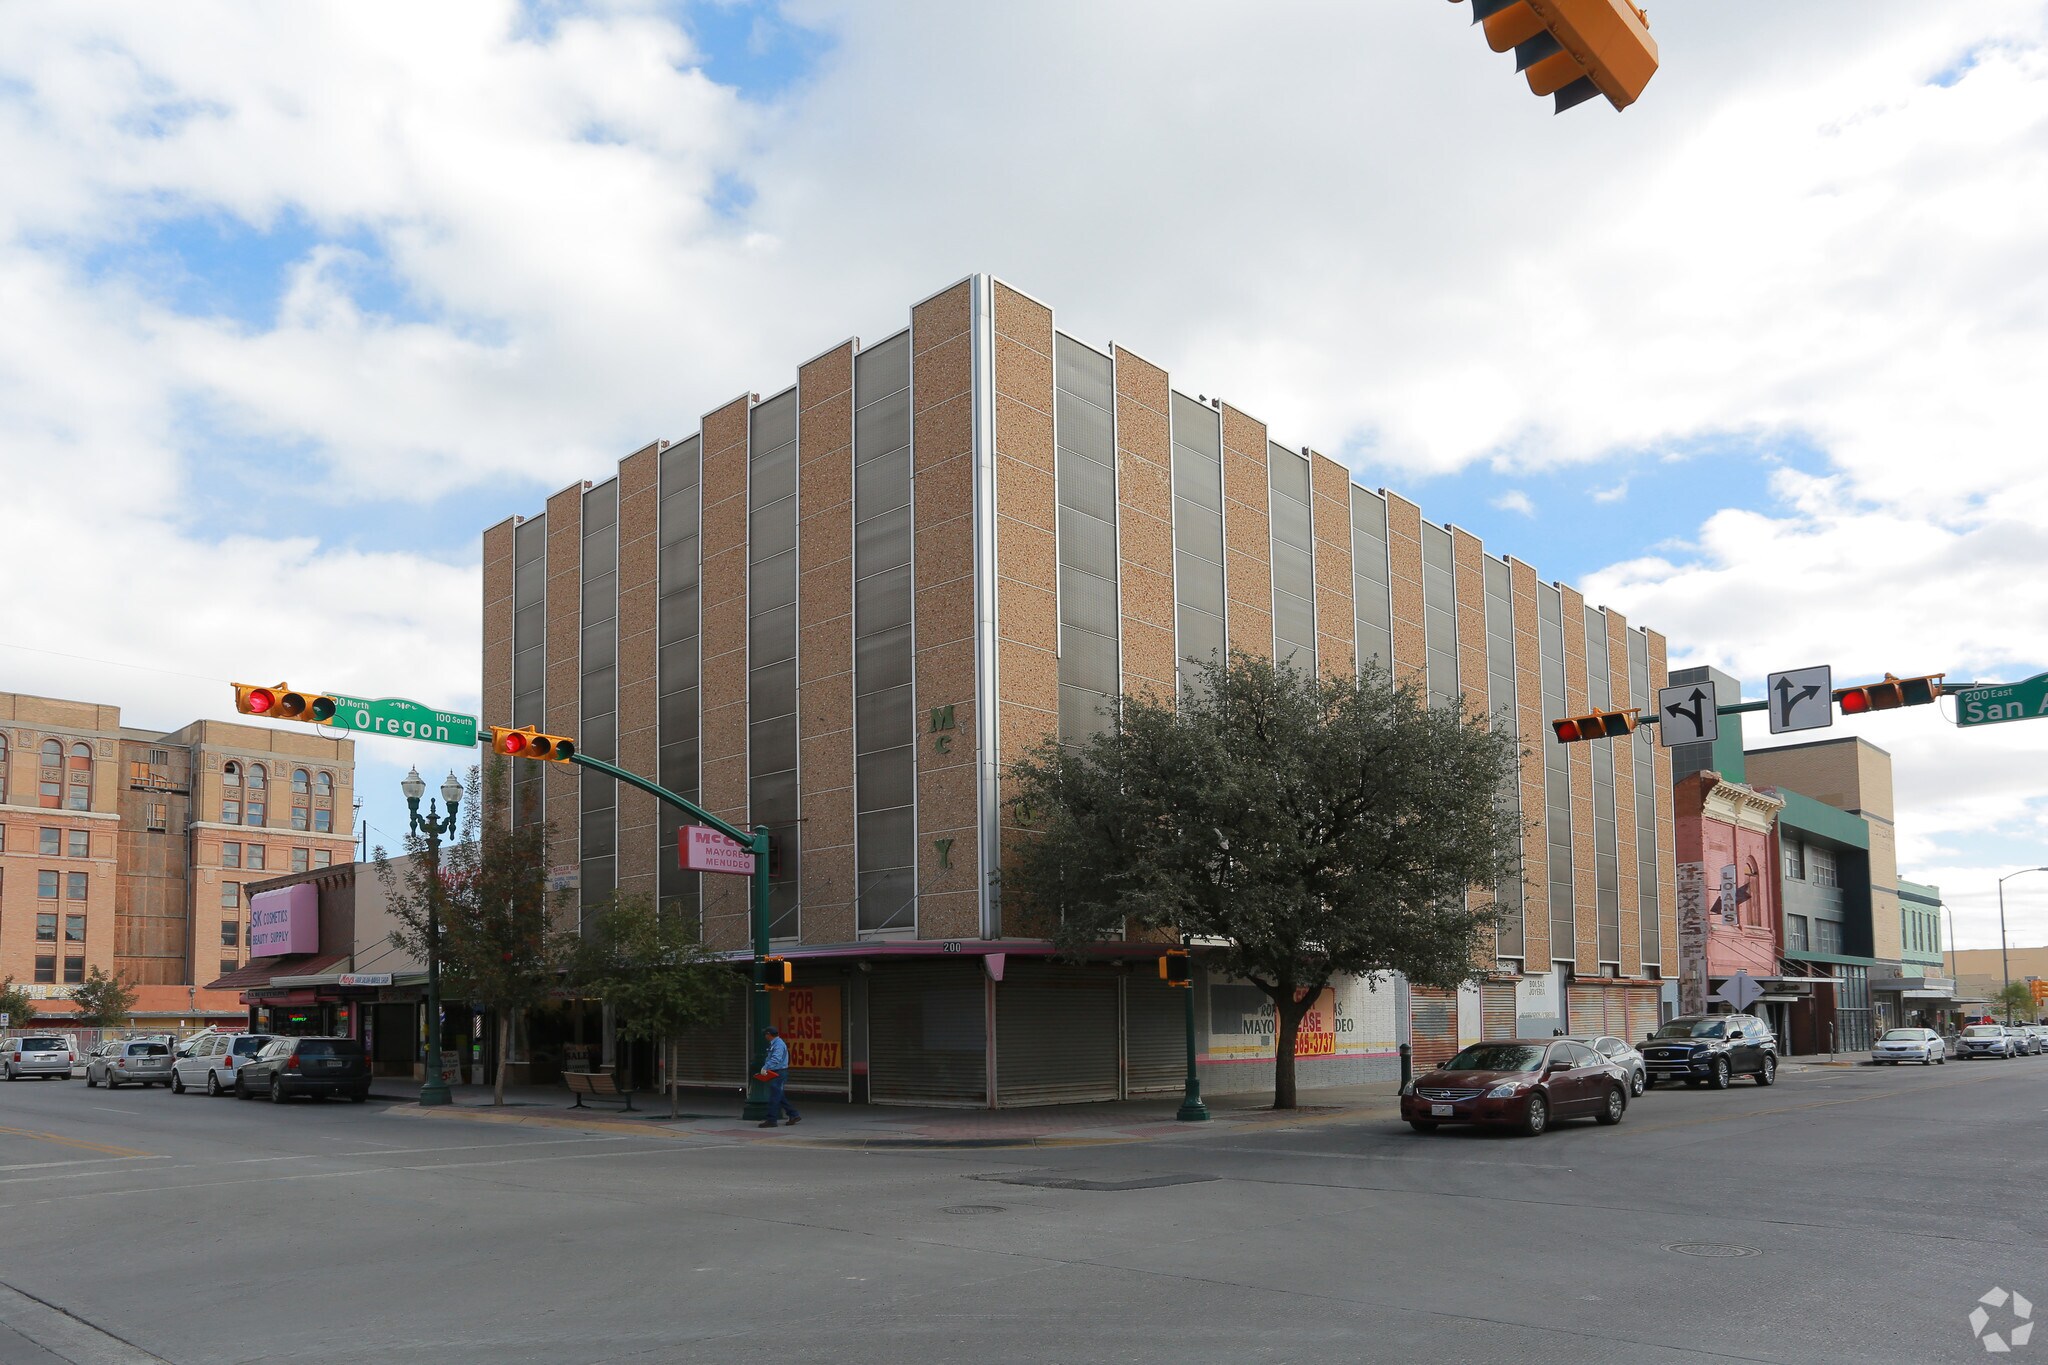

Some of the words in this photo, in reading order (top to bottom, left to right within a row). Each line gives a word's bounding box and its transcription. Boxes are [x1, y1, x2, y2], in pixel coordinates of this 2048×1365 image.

[1965, 690, 1989, 702] 200
[1991, 688, 2013, 698] East
[347, 699, 369, 710] North
[1966, 701, 2024, 723] San
[355, 709, 449, 741] Oregon
[435, 713, 451, 723] 100
[452, 716, 473, 726] South
[705, 847, 750, 859] MAYOREO
[705, 858, 750, 869] MENUDEO
[1680, 867, 1702, 935] TEXAS
[1722, 871, 1735, 922] LOANS
[252, 910, 262, 928] SK
[263, 909, 288, 926] COSMETICS
[252, 932, 268, 945] BEAUTY
[270, 931, 289, 943] SUPPLY
[943, 942, 961, 952] 200
[1529, 980, 1545, 988] BOLSAS
[1529, 988, 1546, 996] JOYERIA
[788, 991, 813, 1014] FOR
[778, 1016, 822, 1040] LEASE
[1243, 1019, 1275, 1035] MAYO
